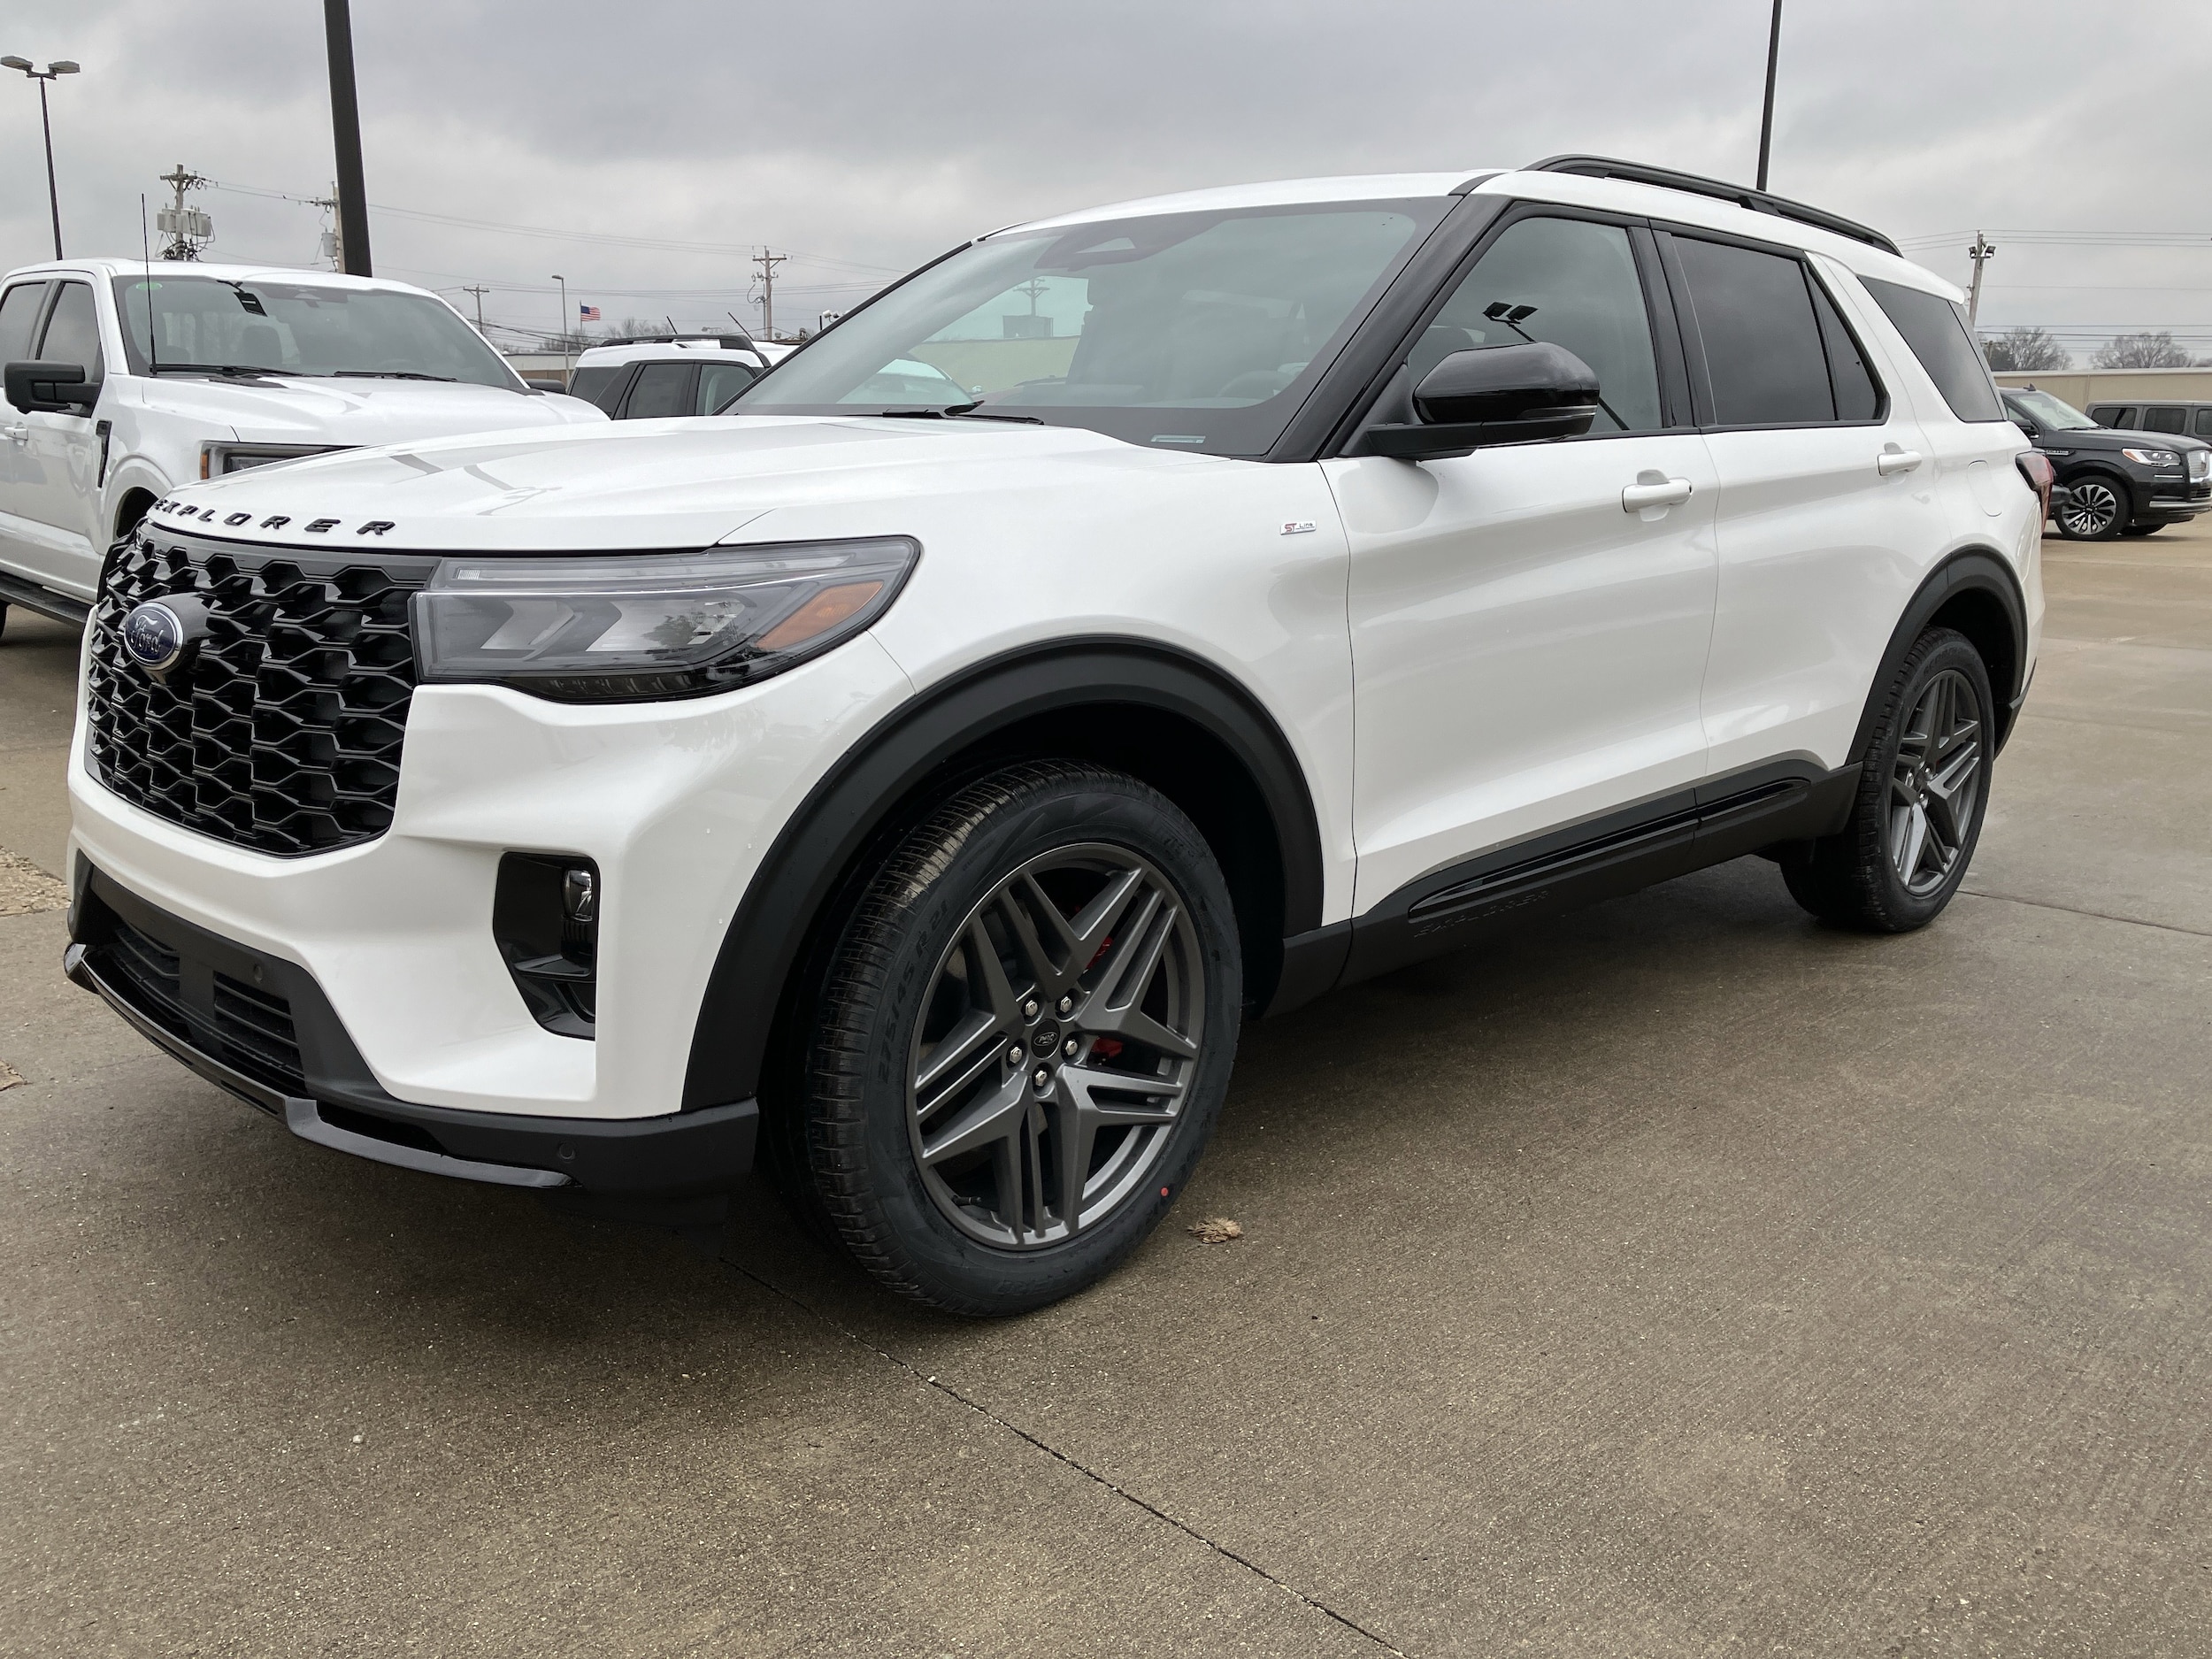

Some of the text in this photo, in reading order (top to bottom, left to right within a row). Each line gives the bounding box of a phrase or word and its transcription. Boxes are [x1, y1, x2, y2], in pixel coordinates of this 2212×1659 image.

[154, 498, 396, 536] EXPLORER
[1284, 523, 1297, 533] ST
[129, 614, 165, 656] Ford
